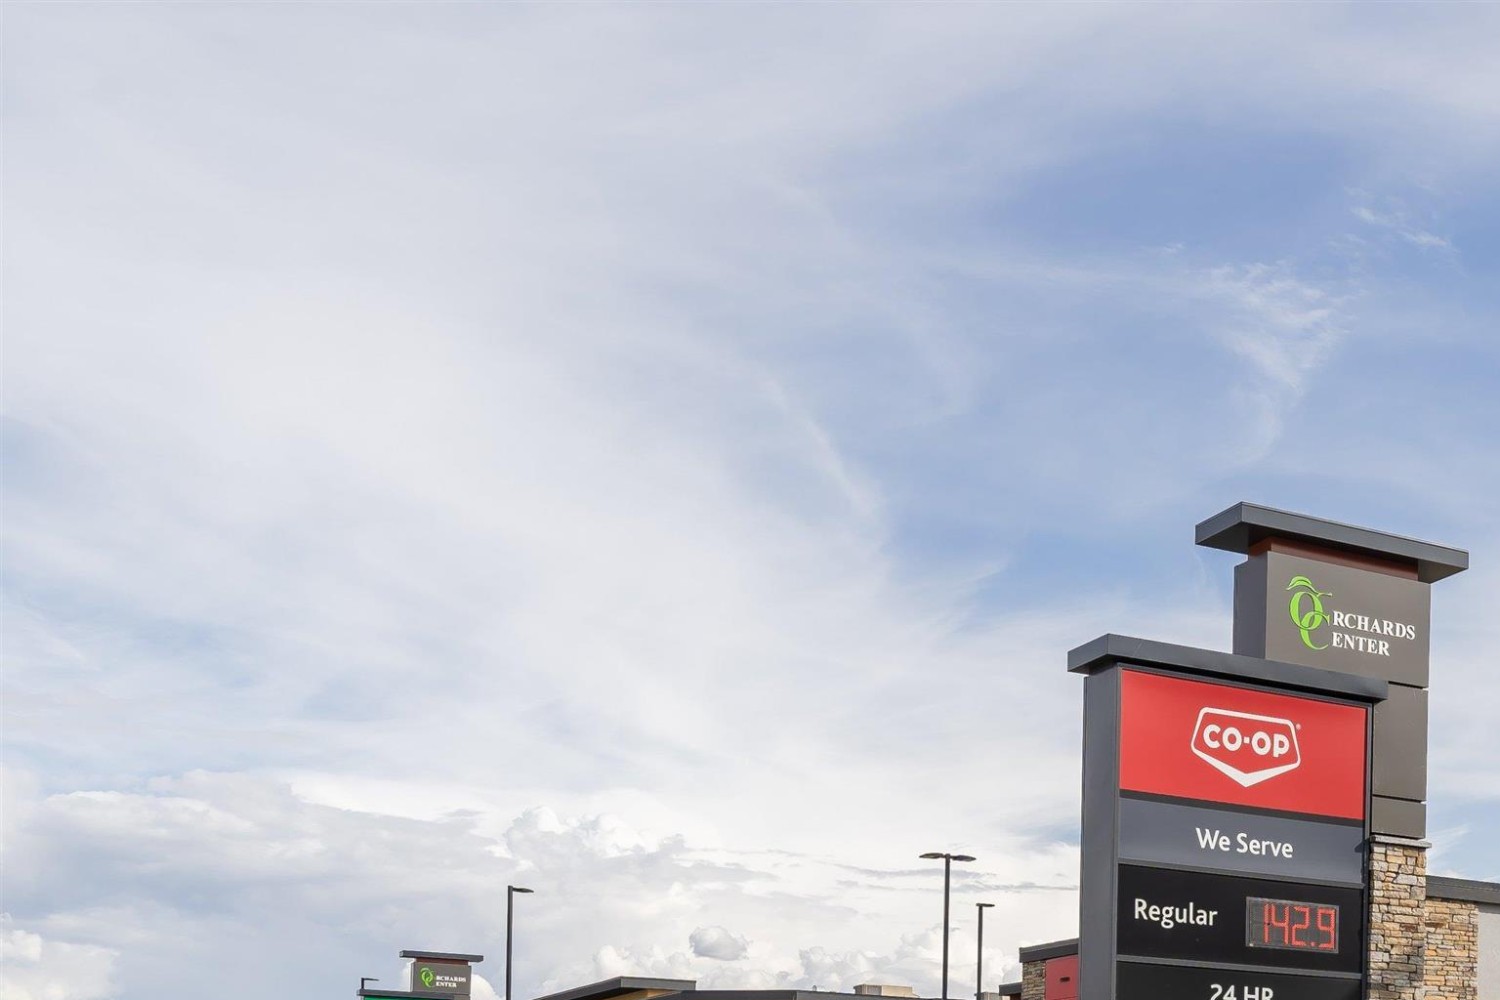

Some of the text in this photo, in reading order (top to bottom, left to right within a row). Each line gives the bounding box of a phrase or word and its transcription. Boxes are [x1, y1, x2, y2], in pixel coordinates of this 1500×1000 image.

[1203, 723, 1290, 758] CO-OP
[1195, 827, 1293, 858] We Serve
[1134, 898, 1218, 929] Regular
